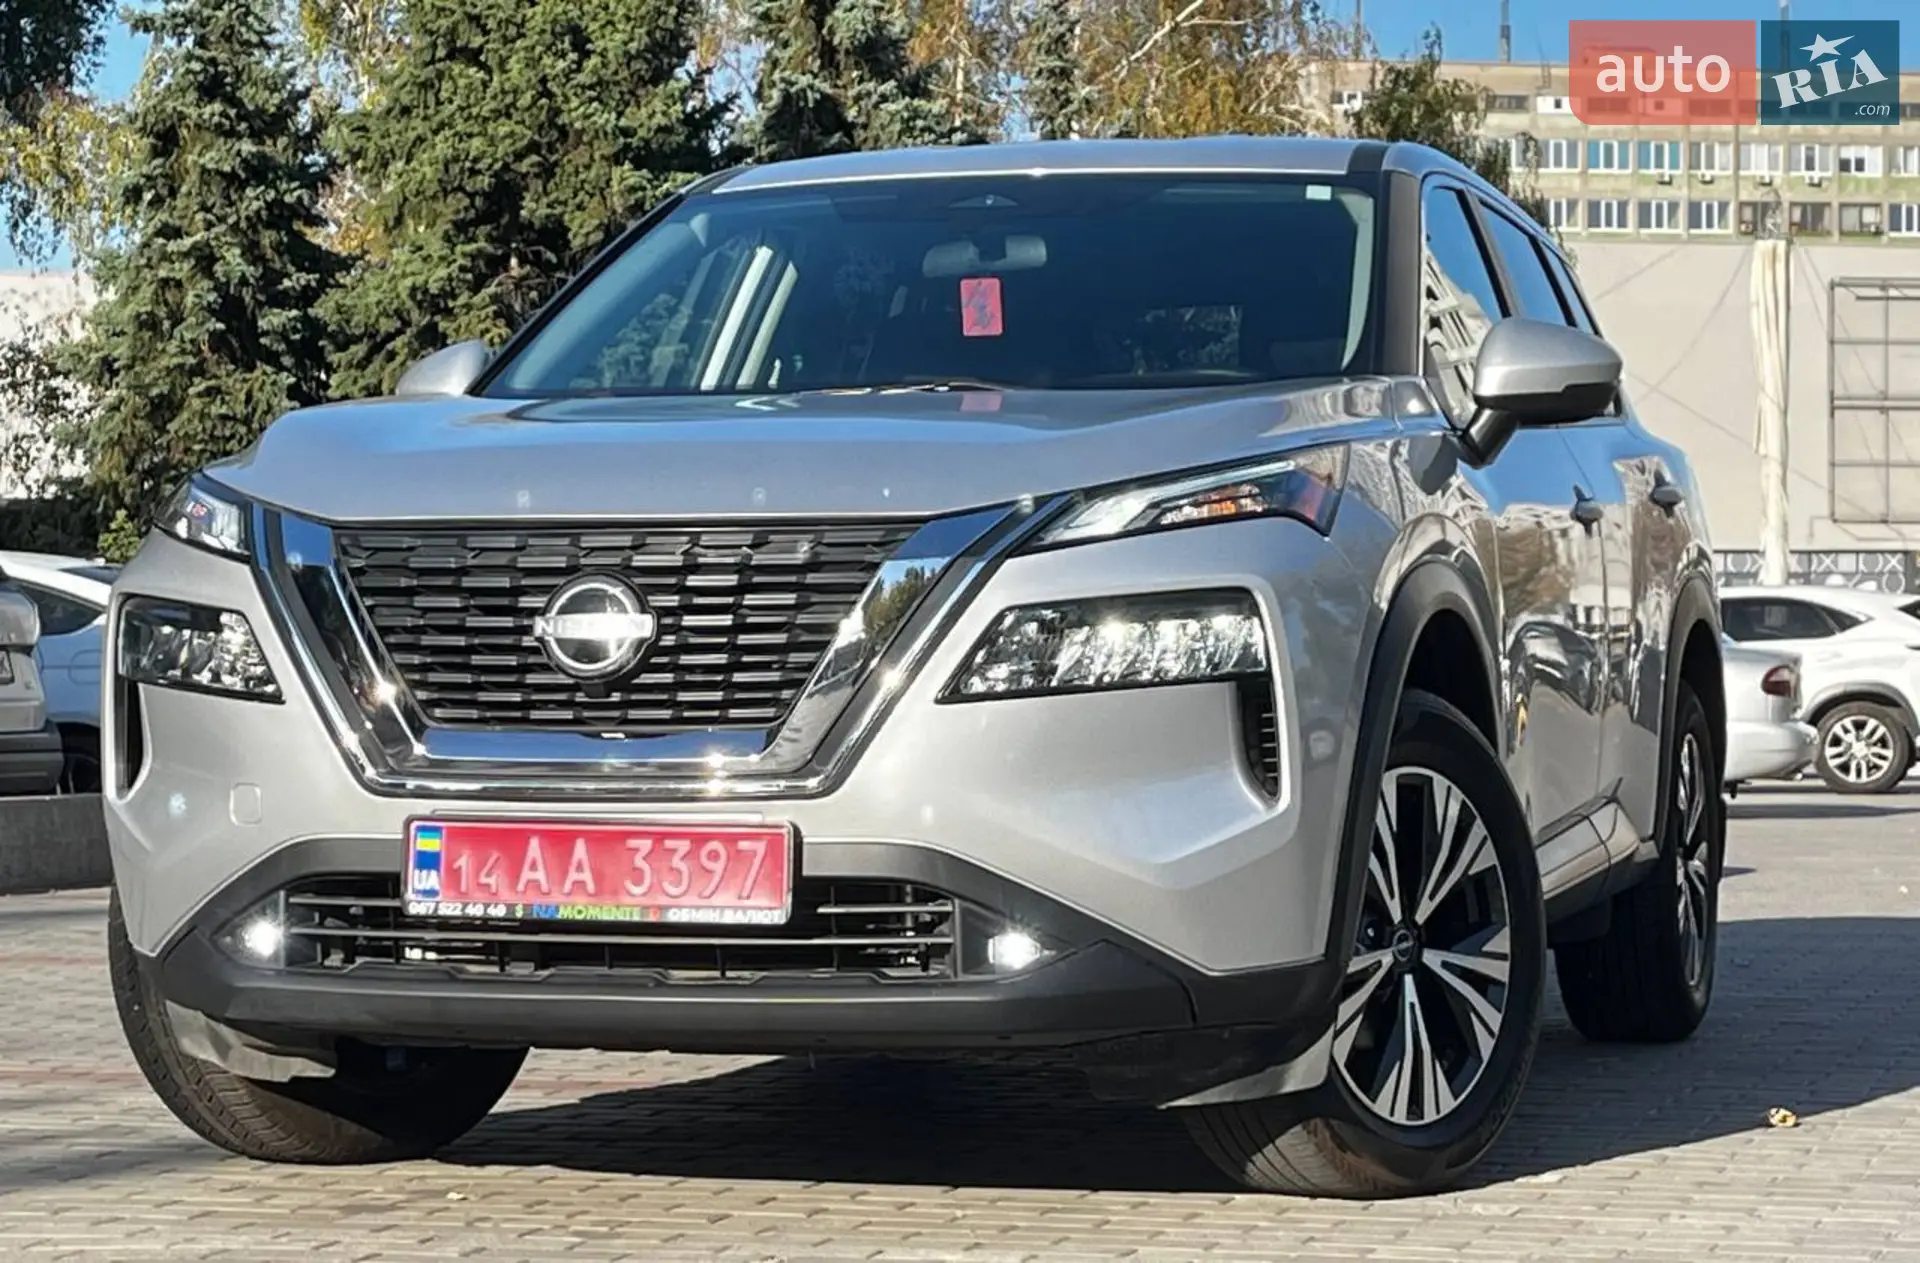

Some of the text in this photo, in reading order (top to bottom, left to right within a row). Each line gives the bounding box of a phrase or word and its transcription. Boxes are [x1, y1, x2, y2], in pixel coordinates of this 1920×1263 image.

[535, 617, 648, 635] NISN
[451, 835, 769, 901] 14 AA 3397
[413, 869, 440, 891] UA
[407, 901, 437, 916] 067
[464, 902, 485, 918] 40
[486, 903, 507, 918] 40
